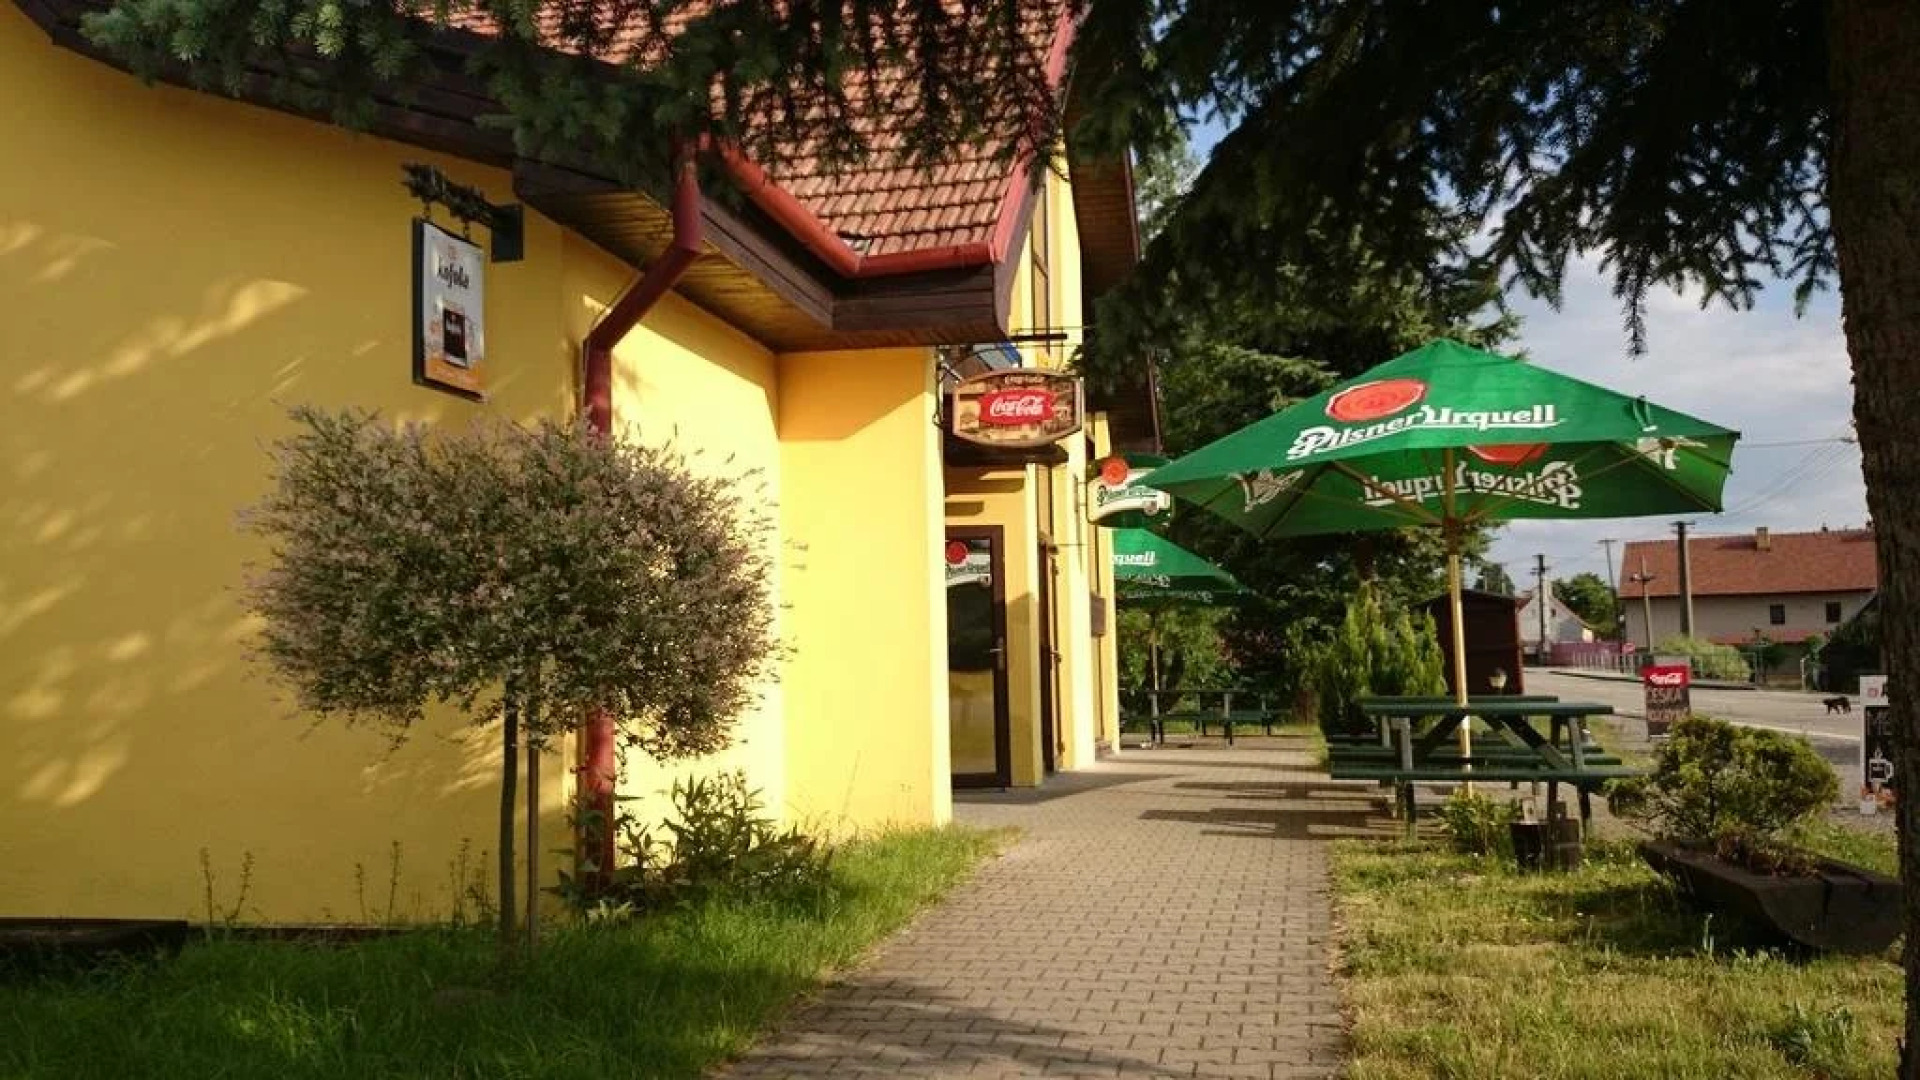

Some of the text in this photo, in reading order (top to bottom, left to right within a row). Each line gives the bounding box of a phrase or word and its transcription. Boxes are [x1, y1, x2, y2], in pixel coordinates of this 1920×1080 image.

[1286, 404, 1557, 460] Pilsner Urquell
[1113, 550, 1156, 567] quell
